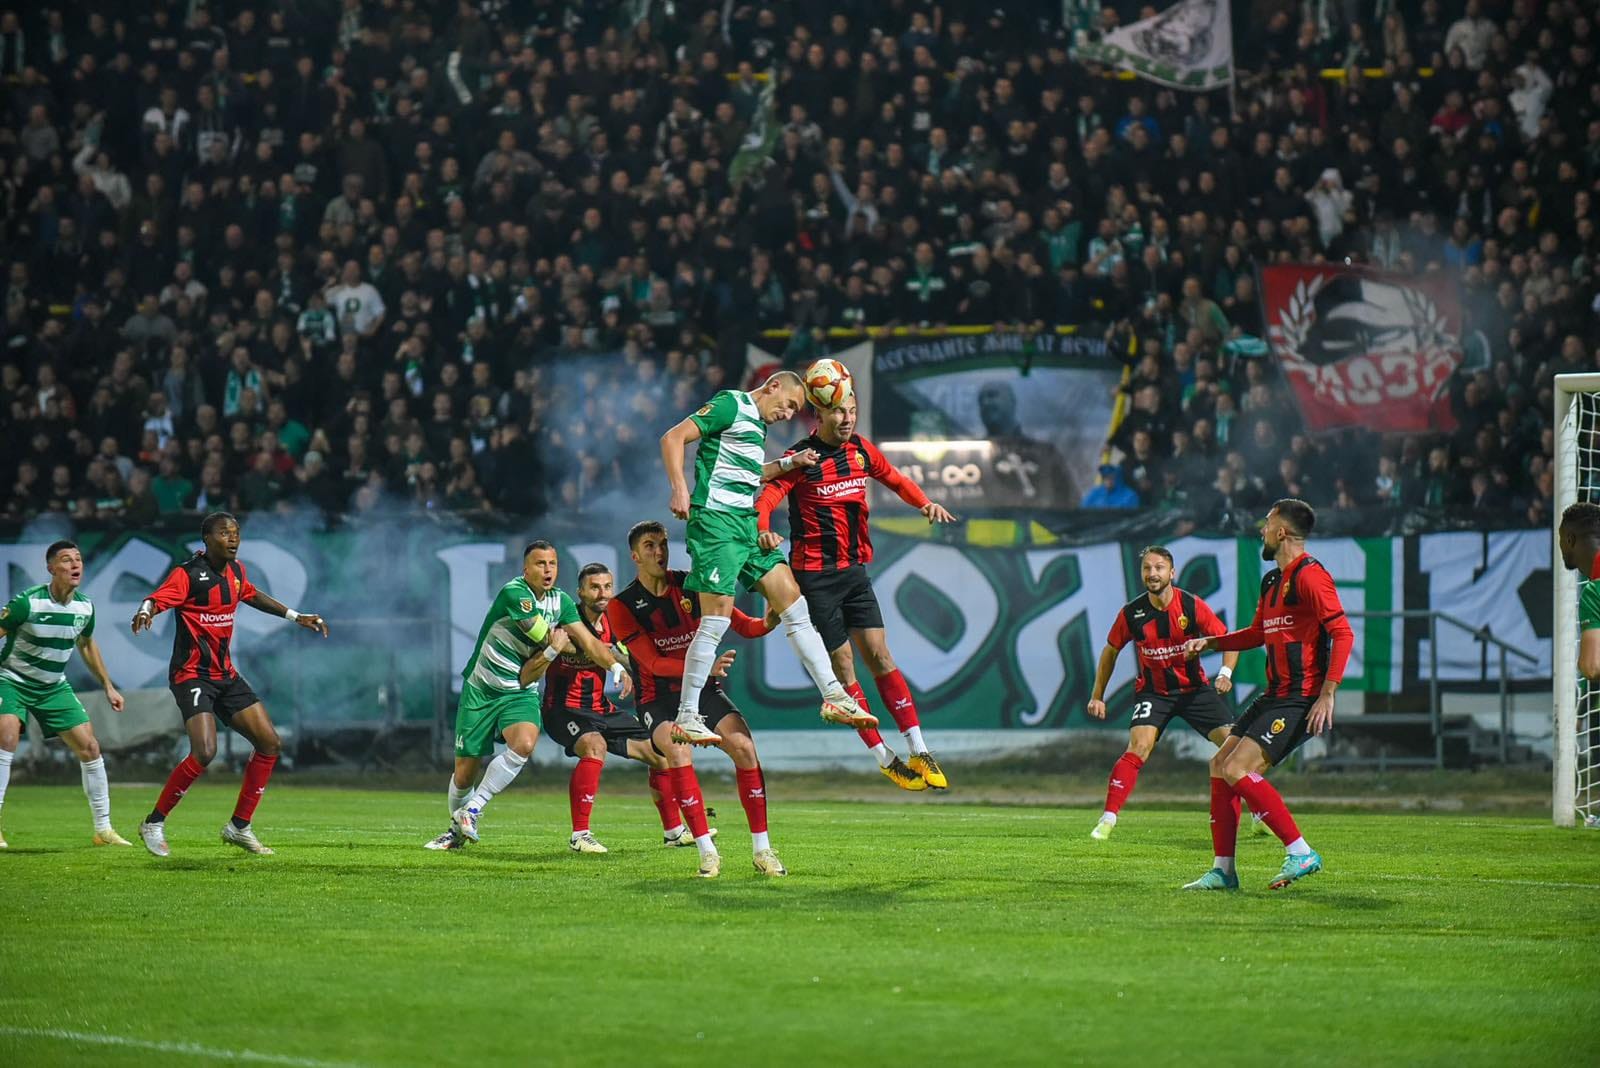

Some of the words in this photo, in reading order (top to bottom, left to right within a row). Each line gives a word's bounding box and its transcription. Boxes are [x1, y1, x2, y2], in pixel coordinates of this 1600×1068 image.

[708, 567, 720, 584] 4
[190, 687, 202, 707] 7
[643, 711, 654, 730] 9
[1131, 701, 1153, 721] 23
[566, 720, 580, 737] 8
